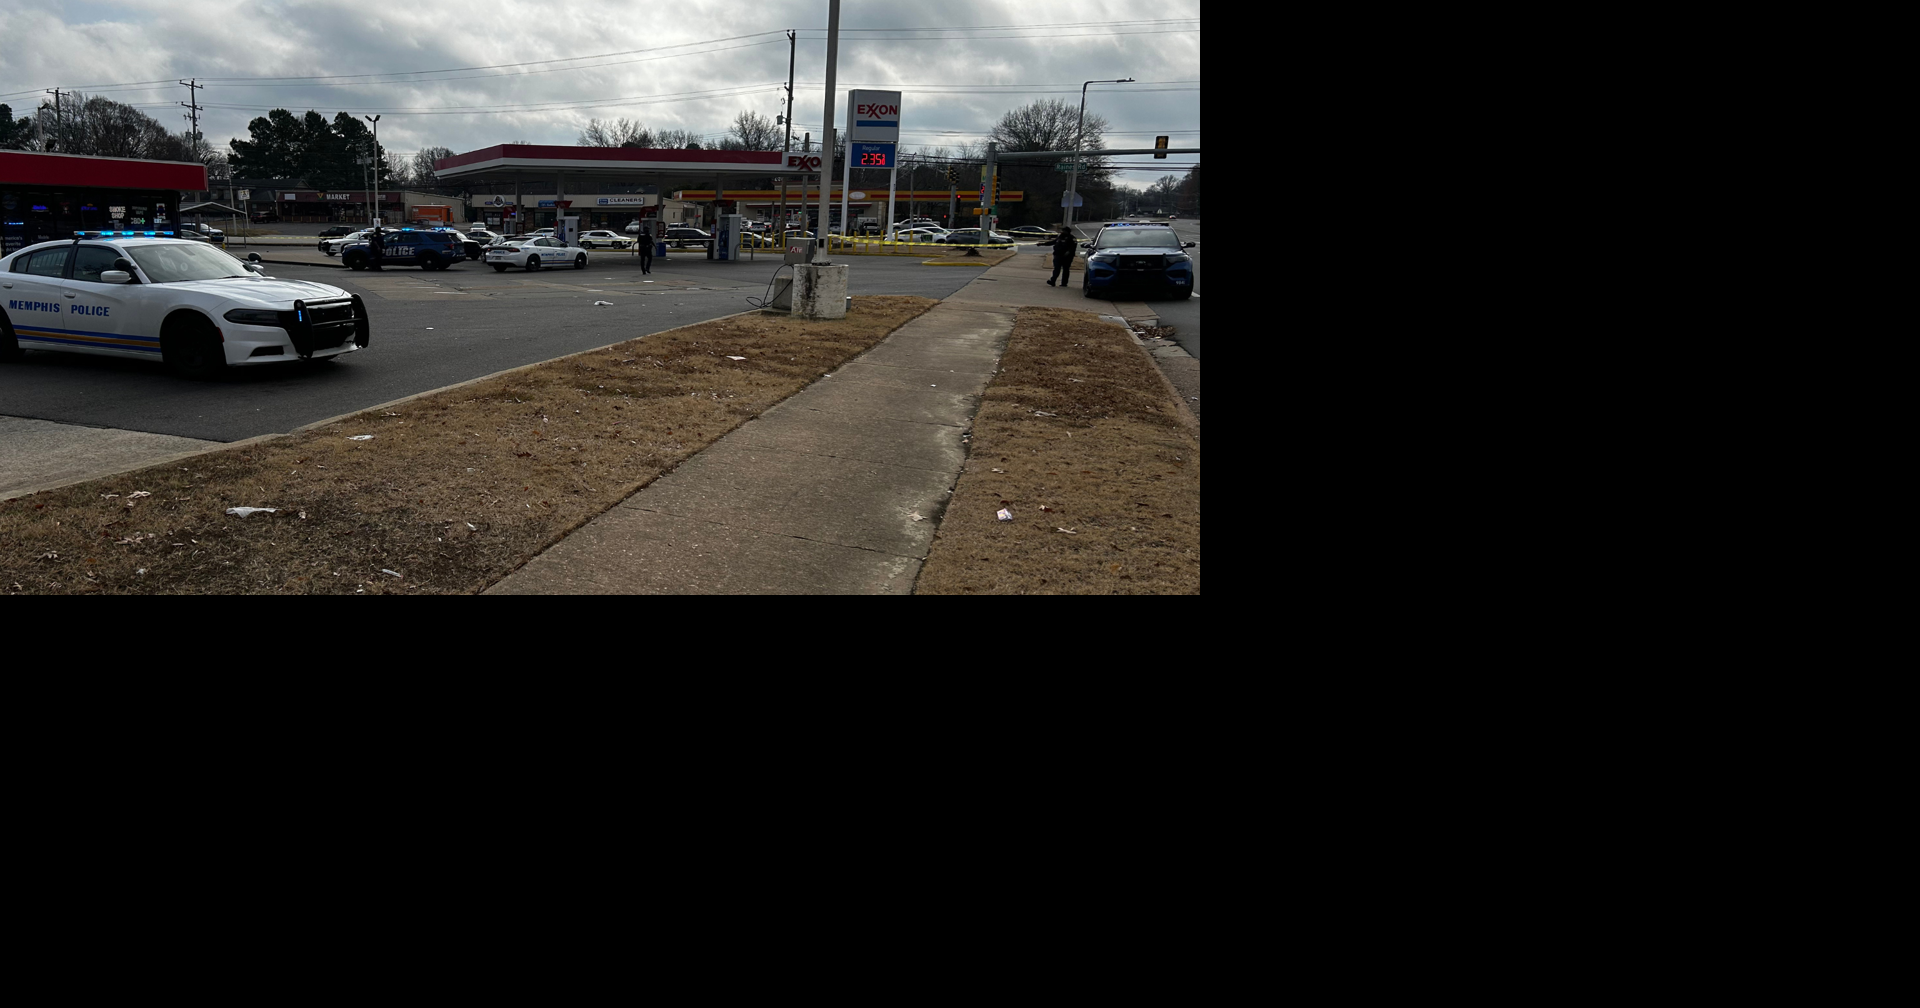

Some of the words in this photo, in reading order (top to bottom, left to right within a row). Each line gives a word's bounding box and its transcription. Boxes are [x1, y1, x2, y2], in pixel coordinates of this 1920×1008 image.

[857, 103, 898, 120] EXXON
[787, 155, 822, 172] EXXO
[9, 300, 60, 313] MEMPHIS
[71, 305, 110, 317] POLICE
